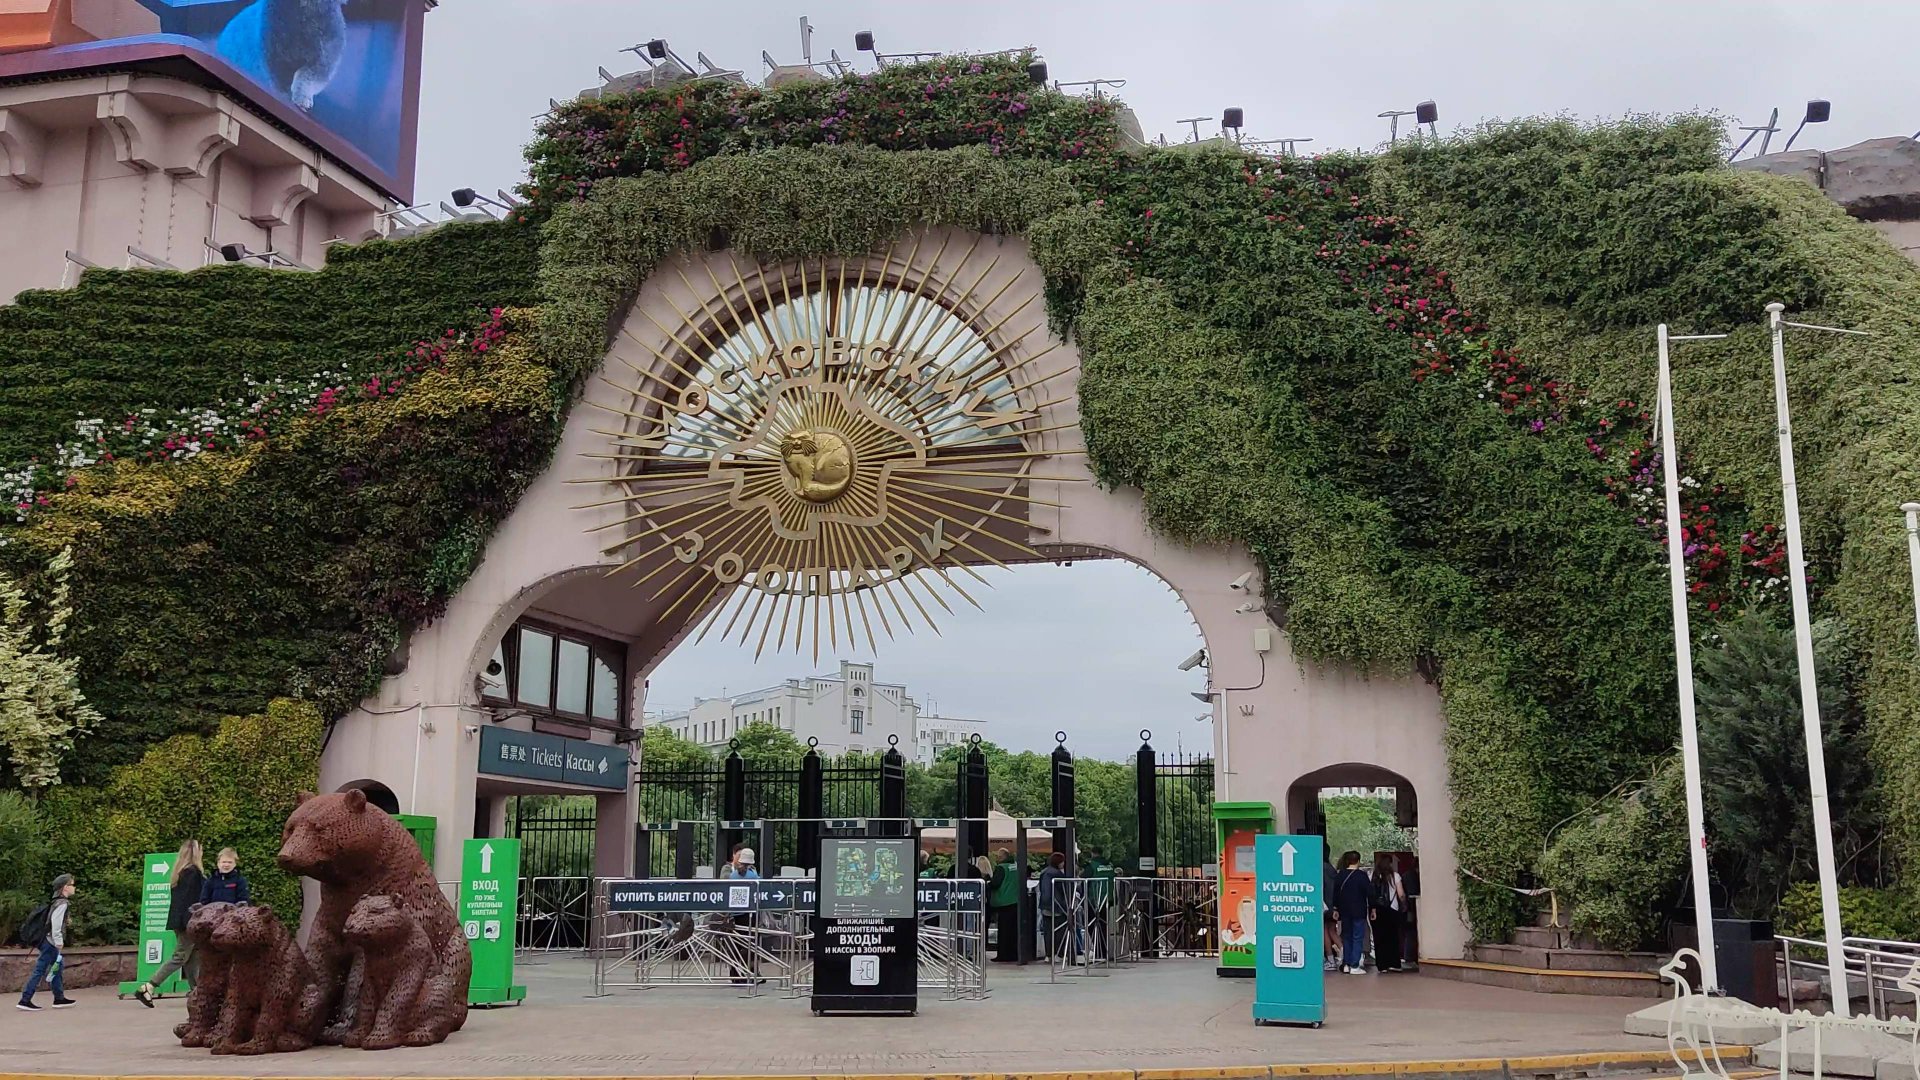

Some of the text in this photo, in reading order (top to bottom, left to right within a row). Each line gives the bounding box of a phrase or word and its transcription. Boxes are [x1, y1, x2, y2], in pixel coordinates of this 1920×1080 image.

[608, 336, 1042, 449] МОСКОВСКИЙ
[674, 518, 956, 597] ЗООПАРК
[500, 743, 595, 773] 售票处 Tickets Кассы
[472, 880, 499, 892] ВХОД
[1262, 882, 1315, 892] КУПИТЬ
[614, 892, 723, 903] КУПИТЬ БИЛЕТ ПО QR
[1270, 895, 1308, 903] БИЛЕТЫ
[1271, 905, 1315, 913] ЗООПАРК
[1273, 914, 1304, 923] (КАССЫ)
[826, 925, 895, 934] ДОПОЛНИТЕЛЬНЫЕ
[839, 934, 882, 947] ВХОДЫ
[825, 946, 896, 954] И КАССЫ В ЗООПАРК
